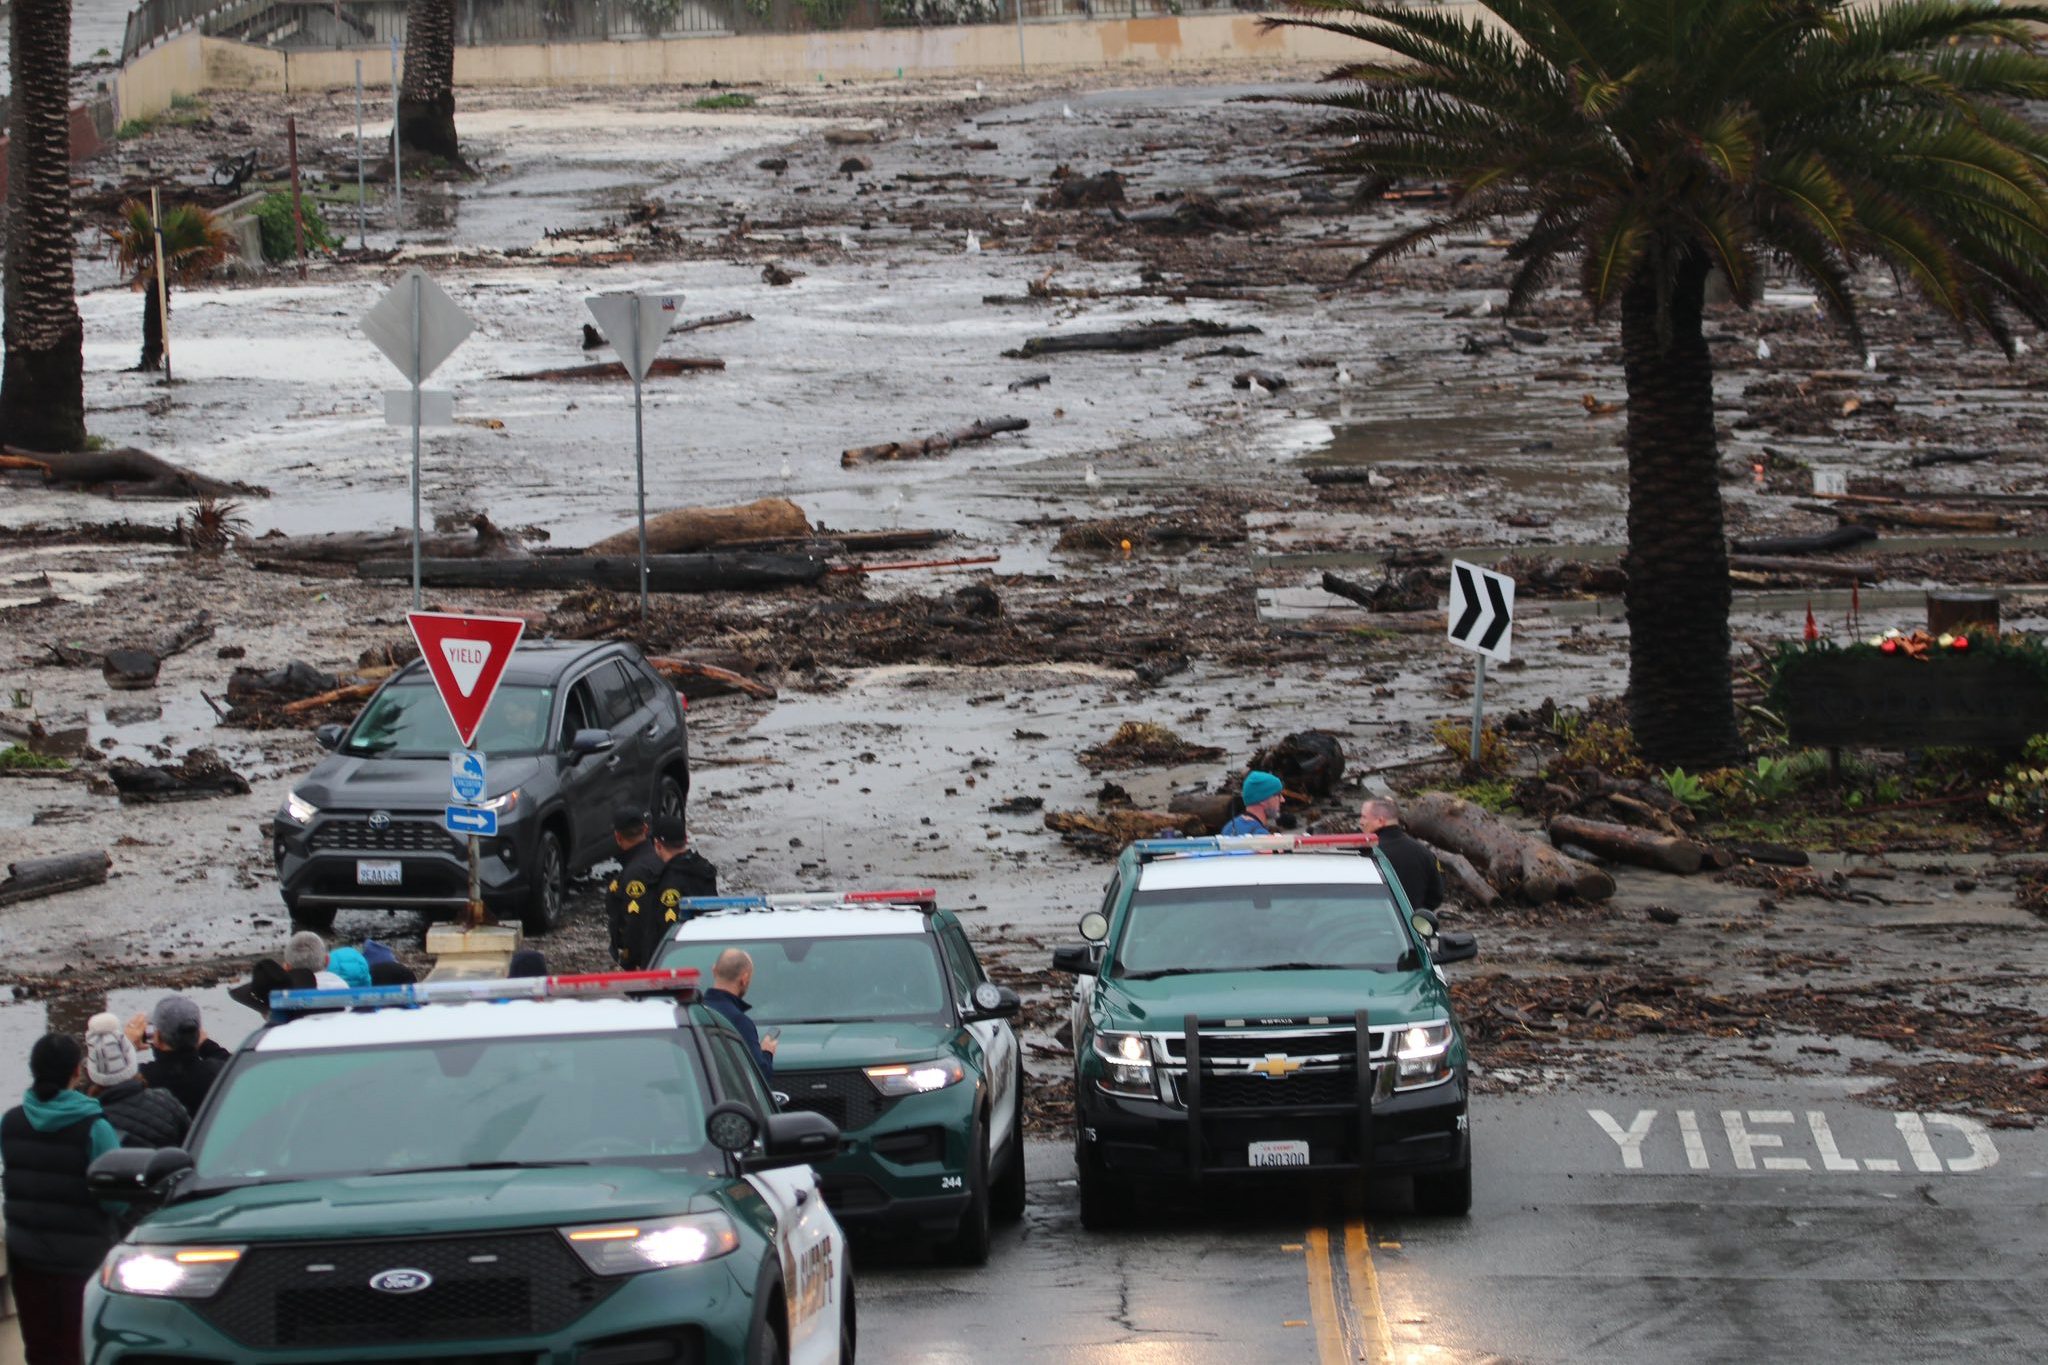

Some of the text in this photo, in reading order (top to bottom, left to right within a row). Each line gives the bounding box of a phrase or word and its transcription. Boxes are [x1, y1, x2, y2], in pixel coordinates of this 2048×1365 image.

[449, 647, 483, 664] YIELD
[1587, 1110, 2000, 1171] YIELD
[1254, 1152, 1305, 1168] 1480300
[941, 1175, 962, 1189] 244
